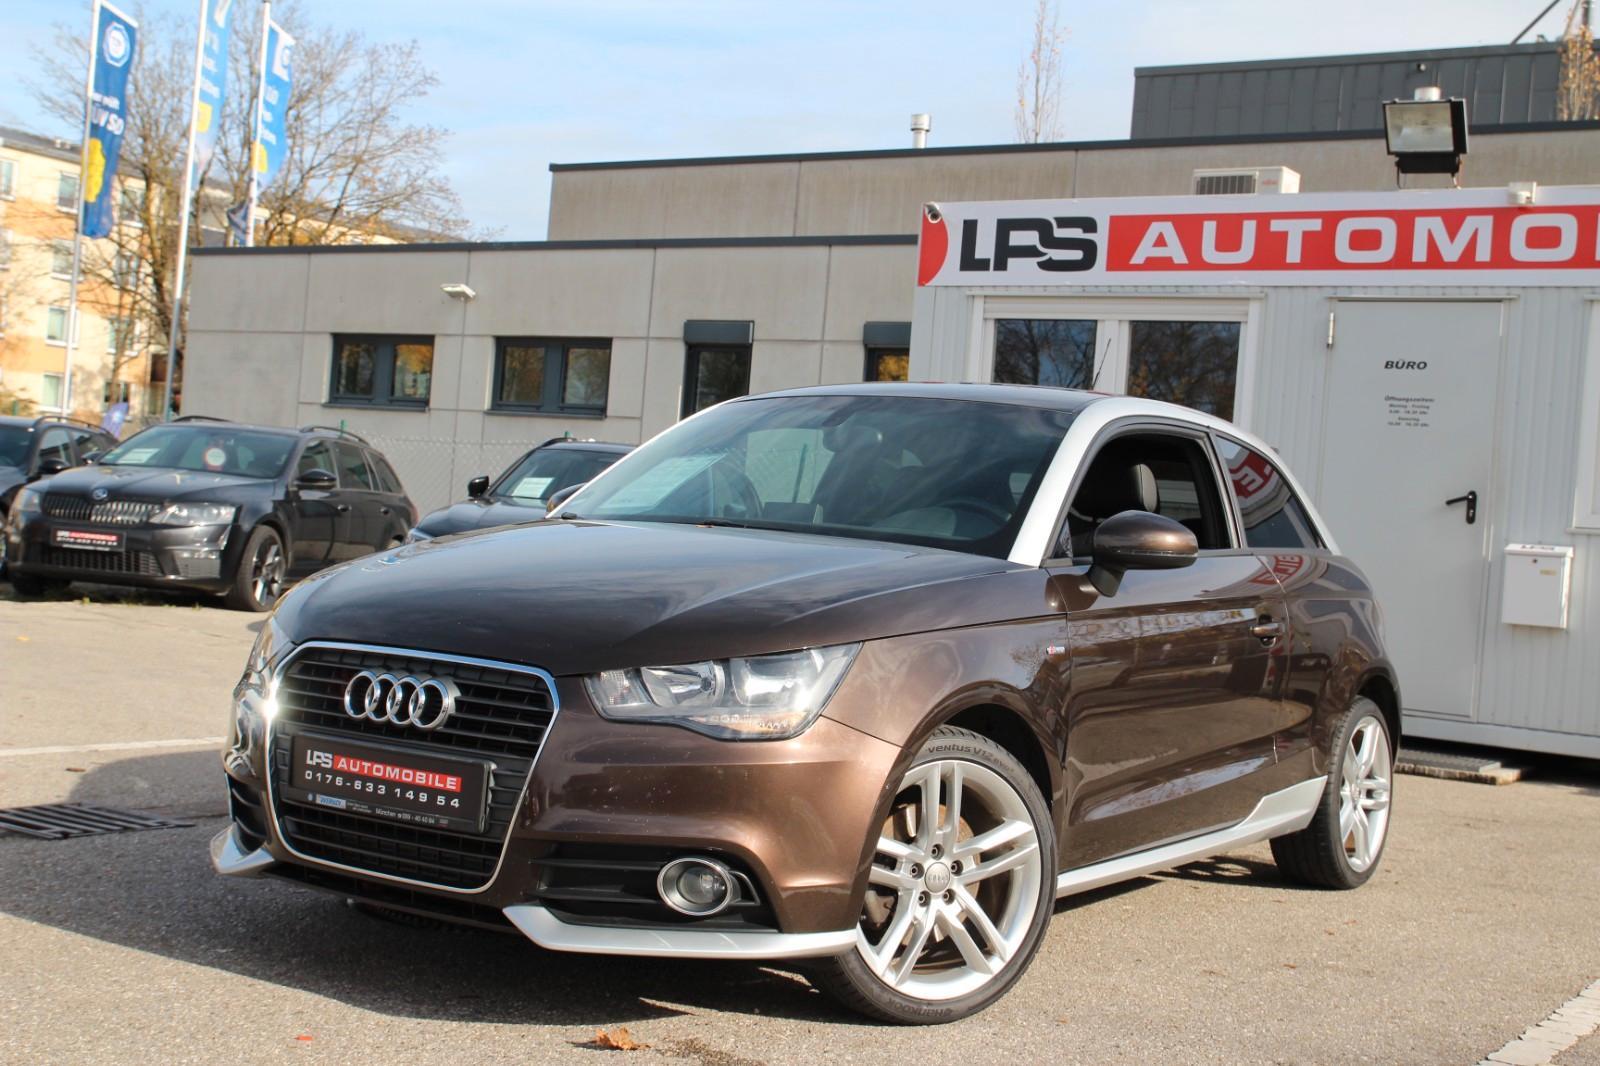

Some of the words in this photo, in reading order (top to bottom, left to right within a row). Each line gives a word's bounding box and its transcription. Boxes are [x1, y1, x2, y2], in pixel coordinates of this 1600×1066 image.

[959, 216, 1098, 272] LPS
[1129, 212, 1600, 265] AUTOMO
[1384, 358, 1427, 370] BÜRO
[305, 770, 386, 795] 0176-633
[394, 788, 428, 803] 149
[436, 795, 461, 809] 54
[306, 750, 334, 769] LPS
[336, 757, 457, 790] AUTOMOBILE
